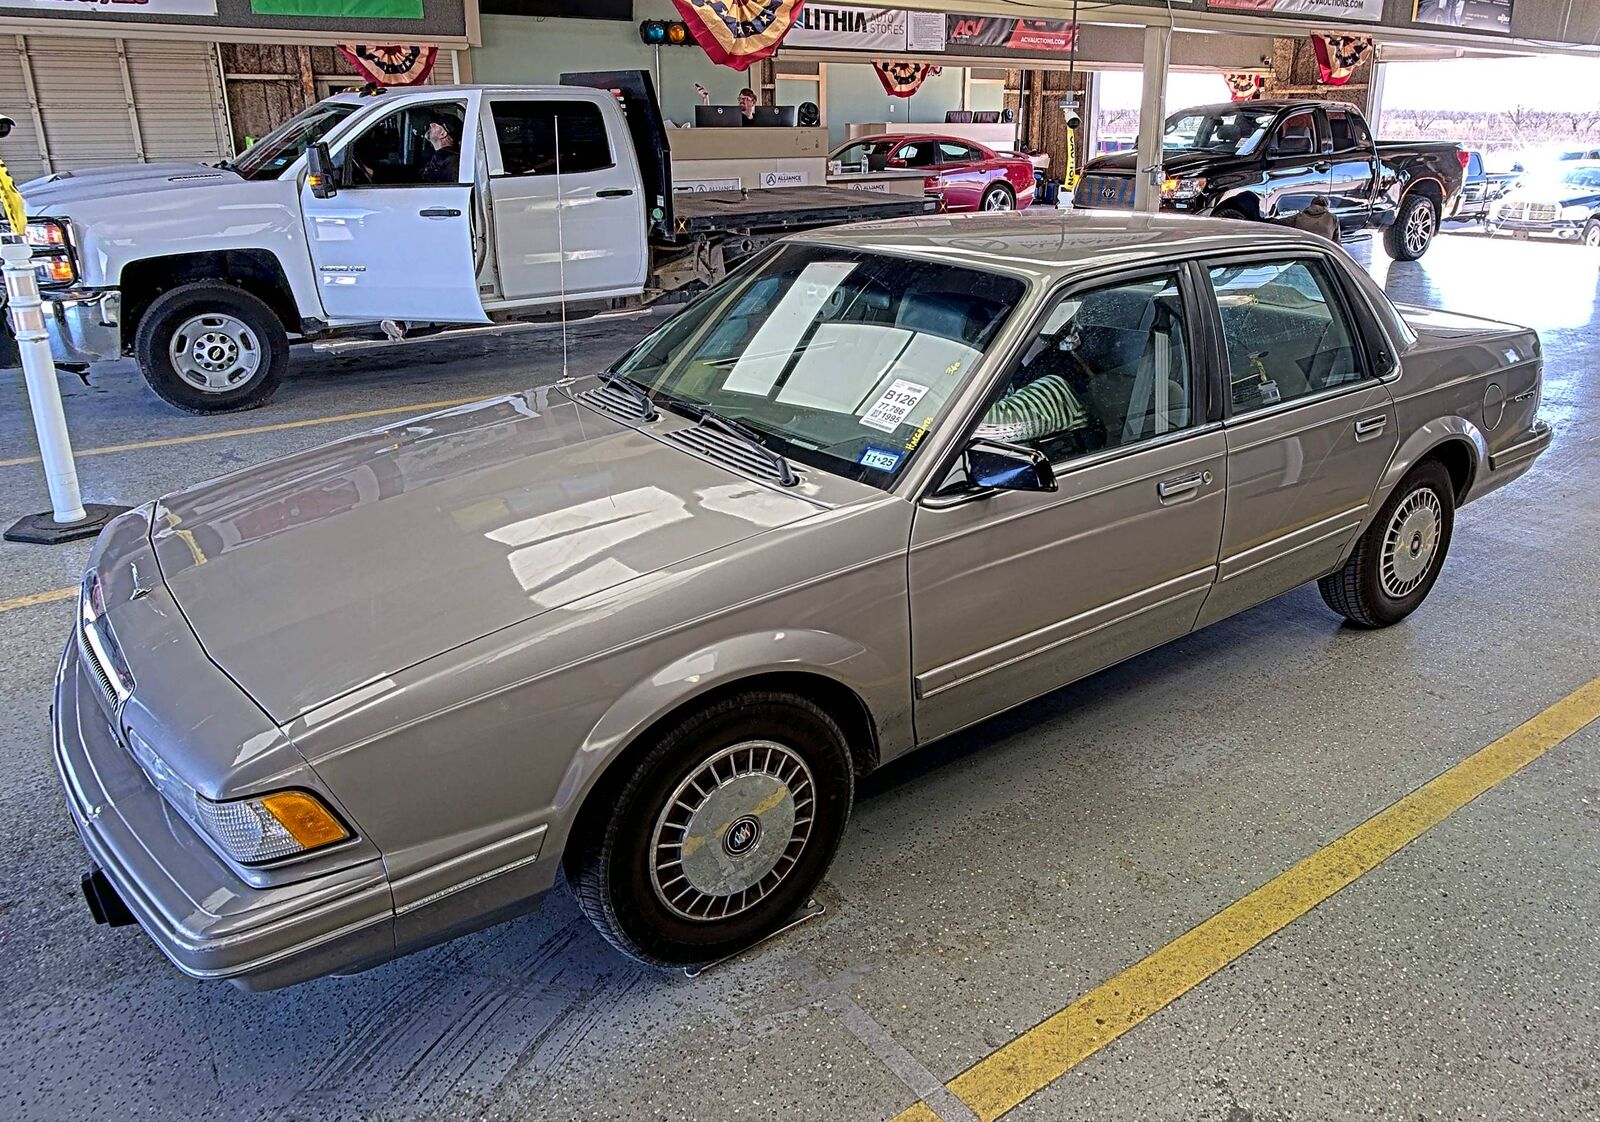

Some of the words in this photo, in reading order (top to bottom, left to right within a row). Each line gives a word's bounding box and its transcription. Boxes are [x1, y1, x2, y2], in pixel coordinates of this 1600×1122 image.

[804, 8, 868, 33] LITHIA
[871, 13, 894, 24] AUTO
[870, 24, 905, 35] STORES
[951, 18, 985, 38] ACV
[1020, 36, 1066, 46] ACVAUCTIONS.COM
[884, 390, 918, 407] B126
[881, 412, 902, 424] 1995
